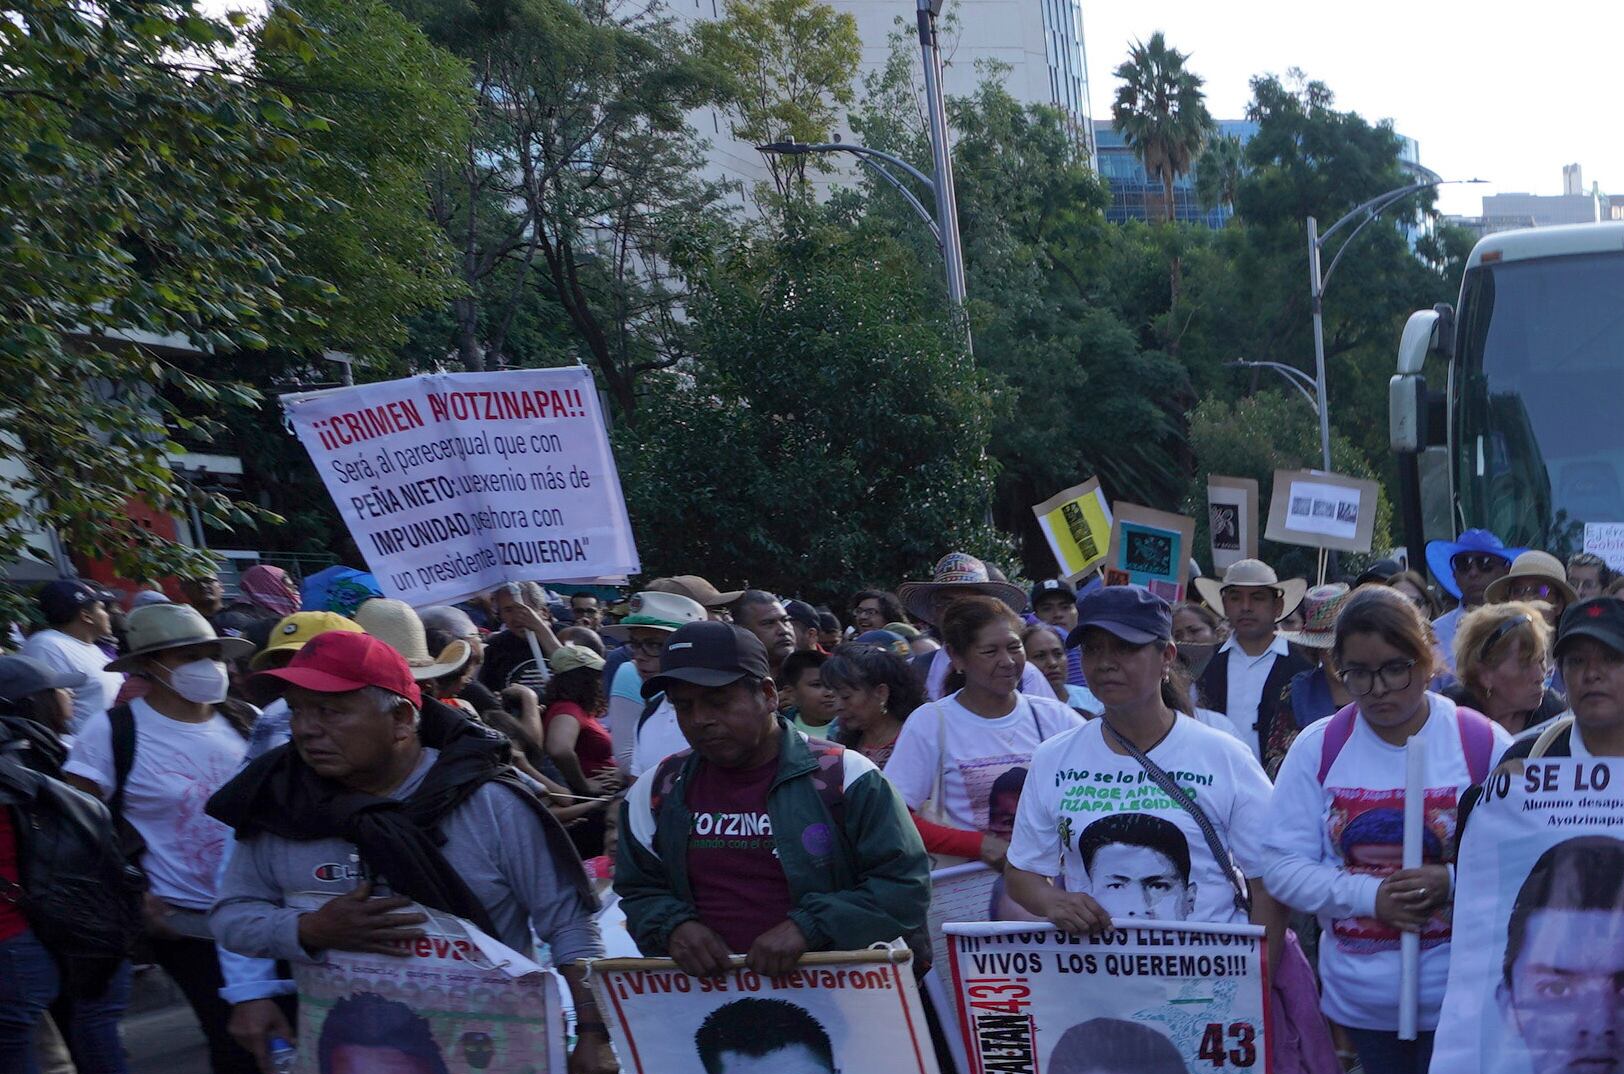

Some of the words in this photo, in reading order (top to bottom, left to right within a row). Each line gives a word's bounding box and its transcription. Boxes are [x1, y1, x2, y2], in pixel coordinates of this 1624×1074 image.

[312, 398, 424, 450] ¡¡CRIMEN
[428, 389, 585, 422] AYOTZINAPA!!
[332, 456, 379, 484] Será,
[376, 451, 396, 474] al
[397, 439, 453, 475] parecer
[453, 429, 490, 461] gual
[495, 433, 527, 457] que
[530, 432, 562, 453] con
[351, 490, 402, 521] PEÑA
[402, 475, 460, 509] NIETO:
[473, 467, 527, 494] exenio
[530, 465, 565, 491] más
[568, 464, 591, 488] de
[369, 511, 471, 557] IMPUNIDAD,
[535, 507, 564, 528] con
[390, 572, 415, 591] un
[416, 546, 497, 588] presidente
[1055, 769, 1089, 788] ¡Vivo
[1093, 771, 1114, 783] se
[1116, 770, 1135, 784] lo
[1064, 785, 1122, 800] JORGE
[1524, 764, 1561, 793] SE
[1573, 763, 1611, 792] LO
[1059, 799, 1114, 812] TIZAPA
[1522, 798, 1573, 813] Alumno
[1054, 928, 1080, 945] SE
[972, 952, 1042, 975] VIVOS
[1056, 953, 1098, 974] LOS
[1105, 954, 1248, 977] QUEREMOS!!!
[614, 969, 691, 1001] ¡Vivo
[700, 971, 728, 993] se
[736, 968, 762, 993] lo
[965, 977, 1032, 1016] 43!
[1200, 1022, 1257, 1069] 43
